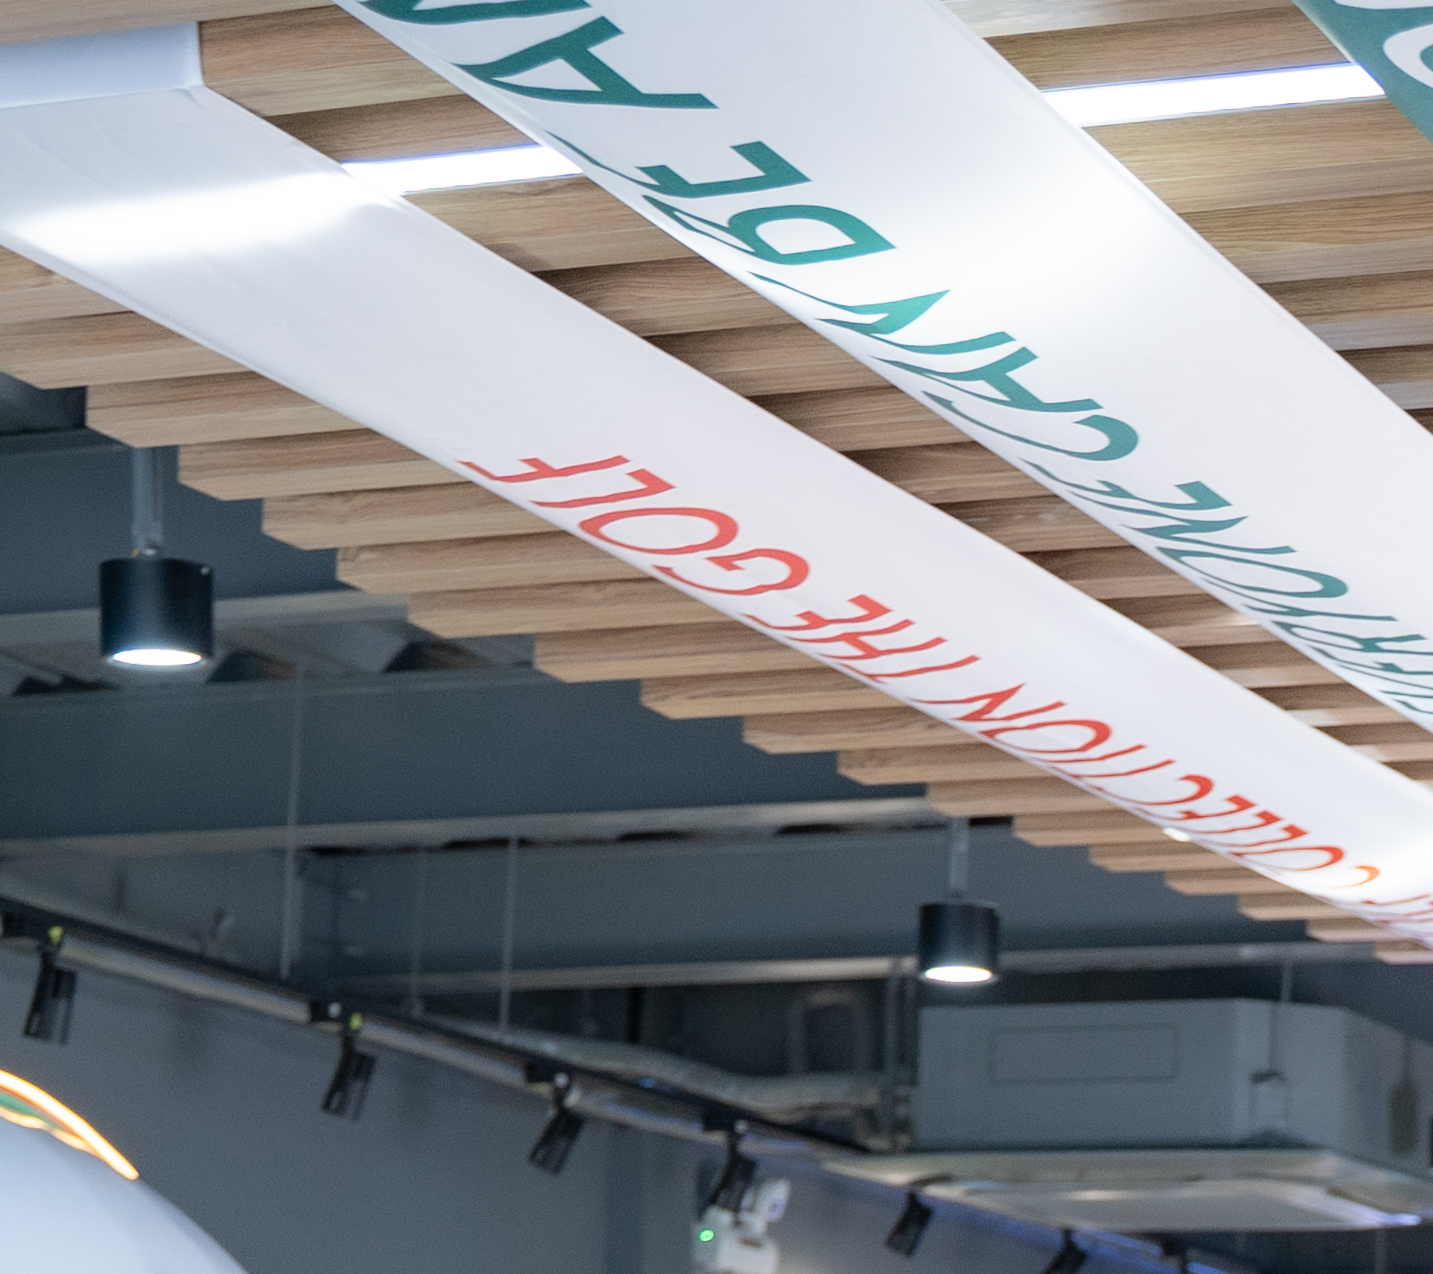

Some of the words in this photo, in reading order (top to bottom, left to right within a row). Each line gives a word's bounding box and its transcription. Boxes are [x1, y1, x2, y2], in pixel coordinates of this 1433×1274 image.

[543, 128, 897, 266] BE
[747, 270, 1140, 461] CAN
[456, 454, 810, 596] GOLF
[741, 593, 981, 683] THE
[907, 683, 1381, 889] COLLECTION
